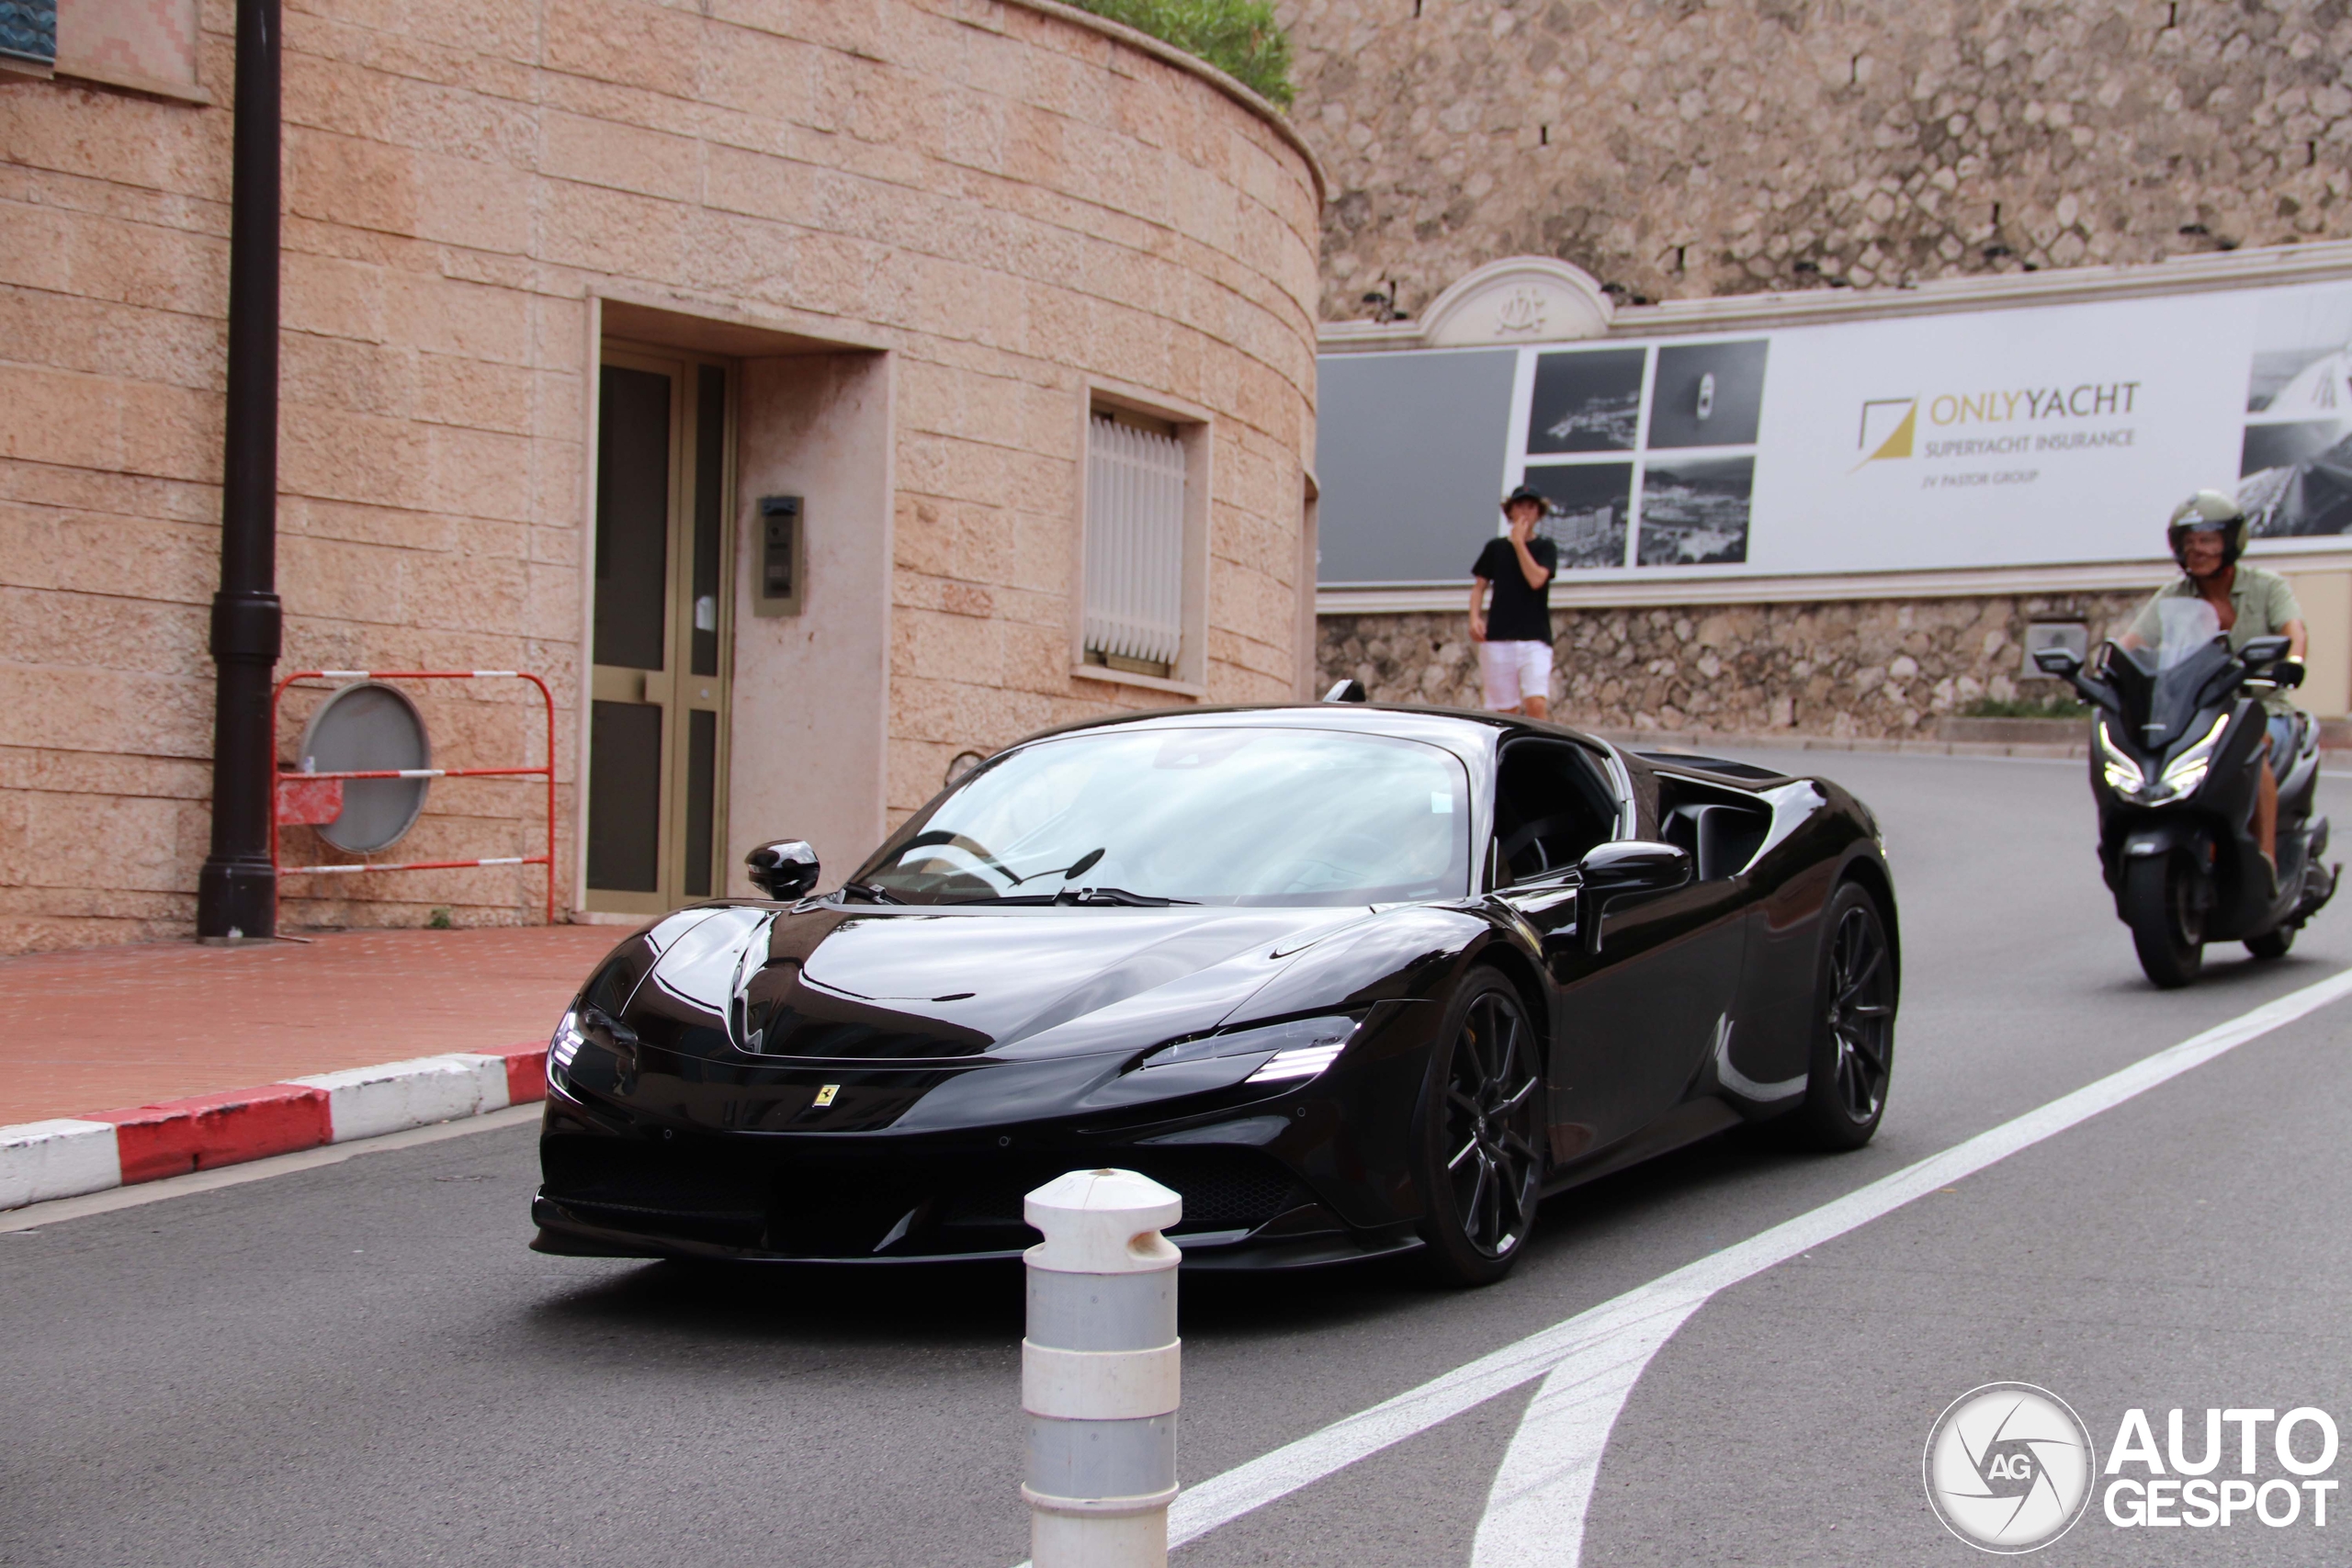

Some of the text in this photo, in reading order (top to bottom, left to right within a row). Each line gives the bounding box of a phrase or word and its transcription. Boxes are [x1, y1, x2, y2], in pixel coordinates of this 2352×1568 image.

[1925, 428, 2136, 458] SUPERYACHT INSURANCE
[1941, 471, 1989, 488] PASTOR
[1992, 468, 2040, 485] GROUP
